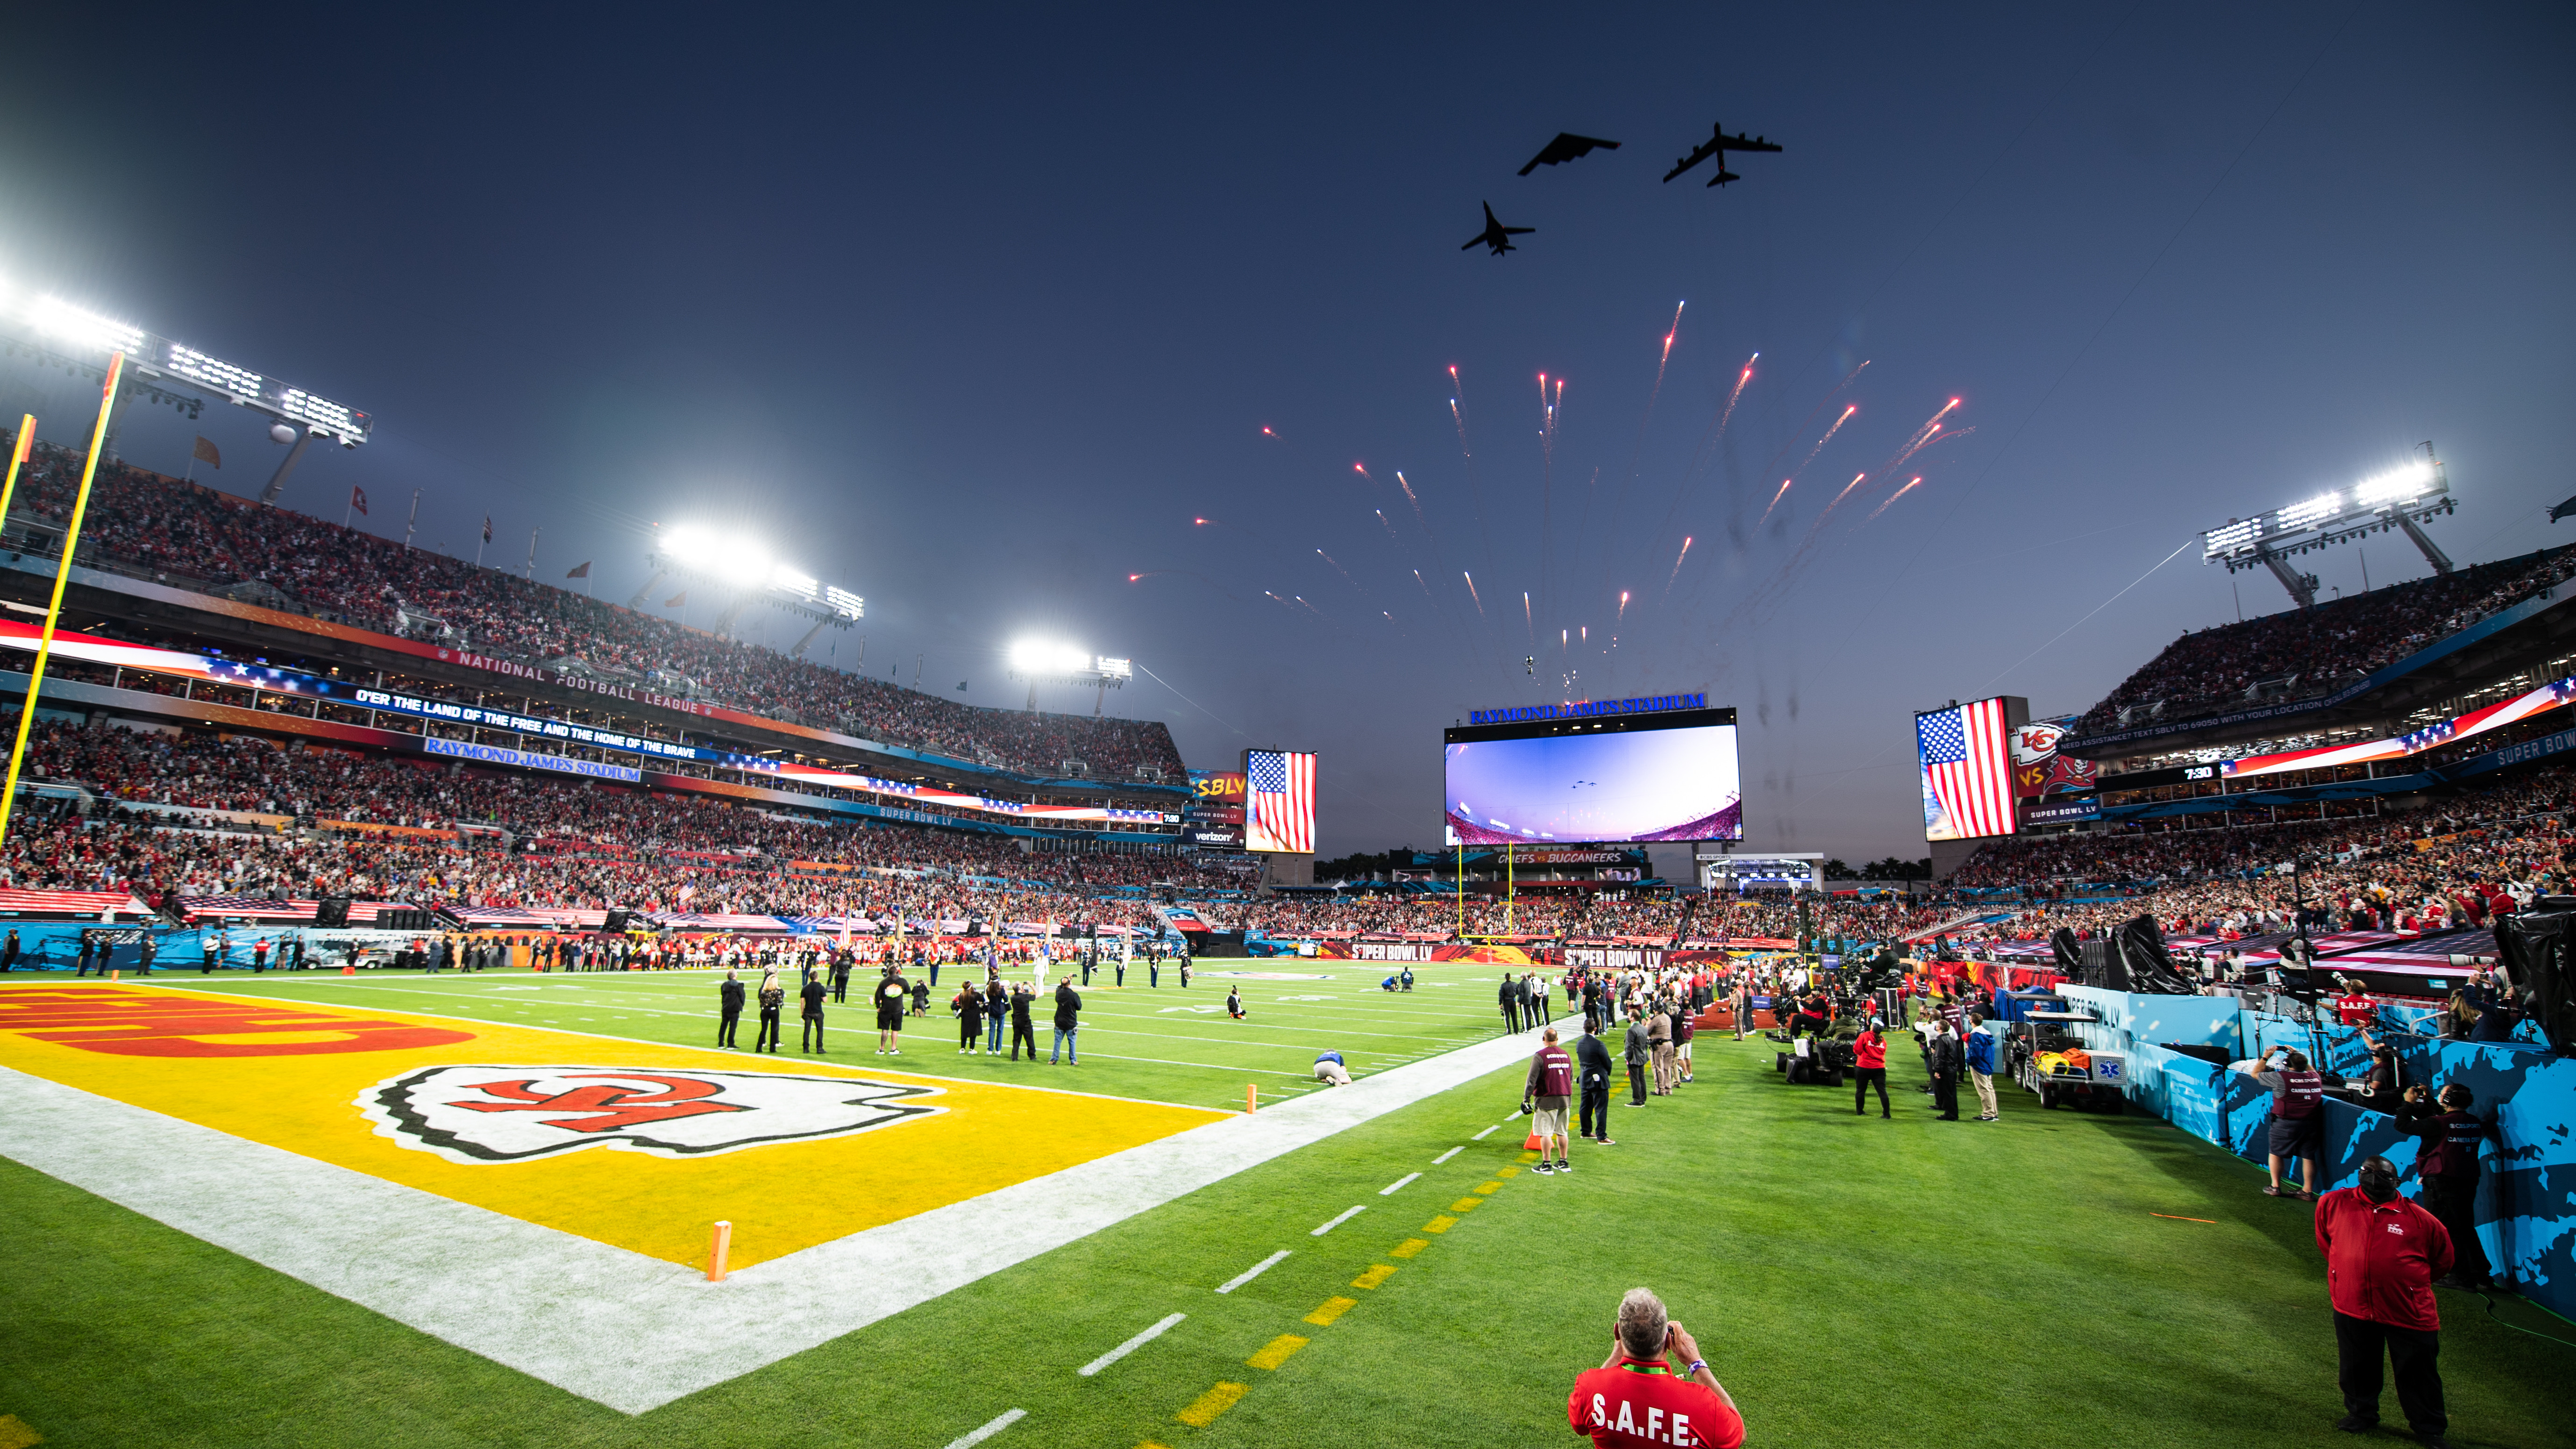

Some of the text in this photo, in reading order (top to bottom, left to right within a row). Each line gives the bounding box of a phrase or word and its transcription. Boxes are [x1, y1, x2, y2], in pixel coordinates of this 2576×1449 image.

[459, 653, 698, 714] NATIONAL FOOTBALL LEAGUE
[1470, 693, 1705, 724] RAYMOND JAMES STADIUM
[356, 689, 696, 759] O'ER THE LAND OF THE FREE AND THE HOME OF THE BRAVE
[2082, 733, 2131, 746] ASSISTANCE?
[2133, 729, 2154, 738] TEXT
[2155, 726, 2176, 735] SBLV
[2191, 718, 2218, 729] 69050
[2220, 714, 2244, 724] WITH
[2246, 710, 2272, 719] YOUR
[2275, 701, 2323, 715] LOCATION
[428, 739, 640, 781] RAYMOND JAMES STADIUM
[2498, 742, 2540, 765] SUPER
[2019, 767, 2044, 787] VS
[2185, 767, 2213, 780] 7:30
[880, 808, 911, 820] SUPER
[914, 813, 938, 824] BOWL
[1164, 814, 1179, 823] 7:30
[1195, 832, 1231, 842] verizon
[1547, 853, 1621, 863] BUCCANEERS
[1352, 944, 1433, 961] SUPER BOWL LV
[1565, 949, 1662, 968] SUPER BOWL LV
[1591, 1393, 1699, 1447] S.A.F.E.
